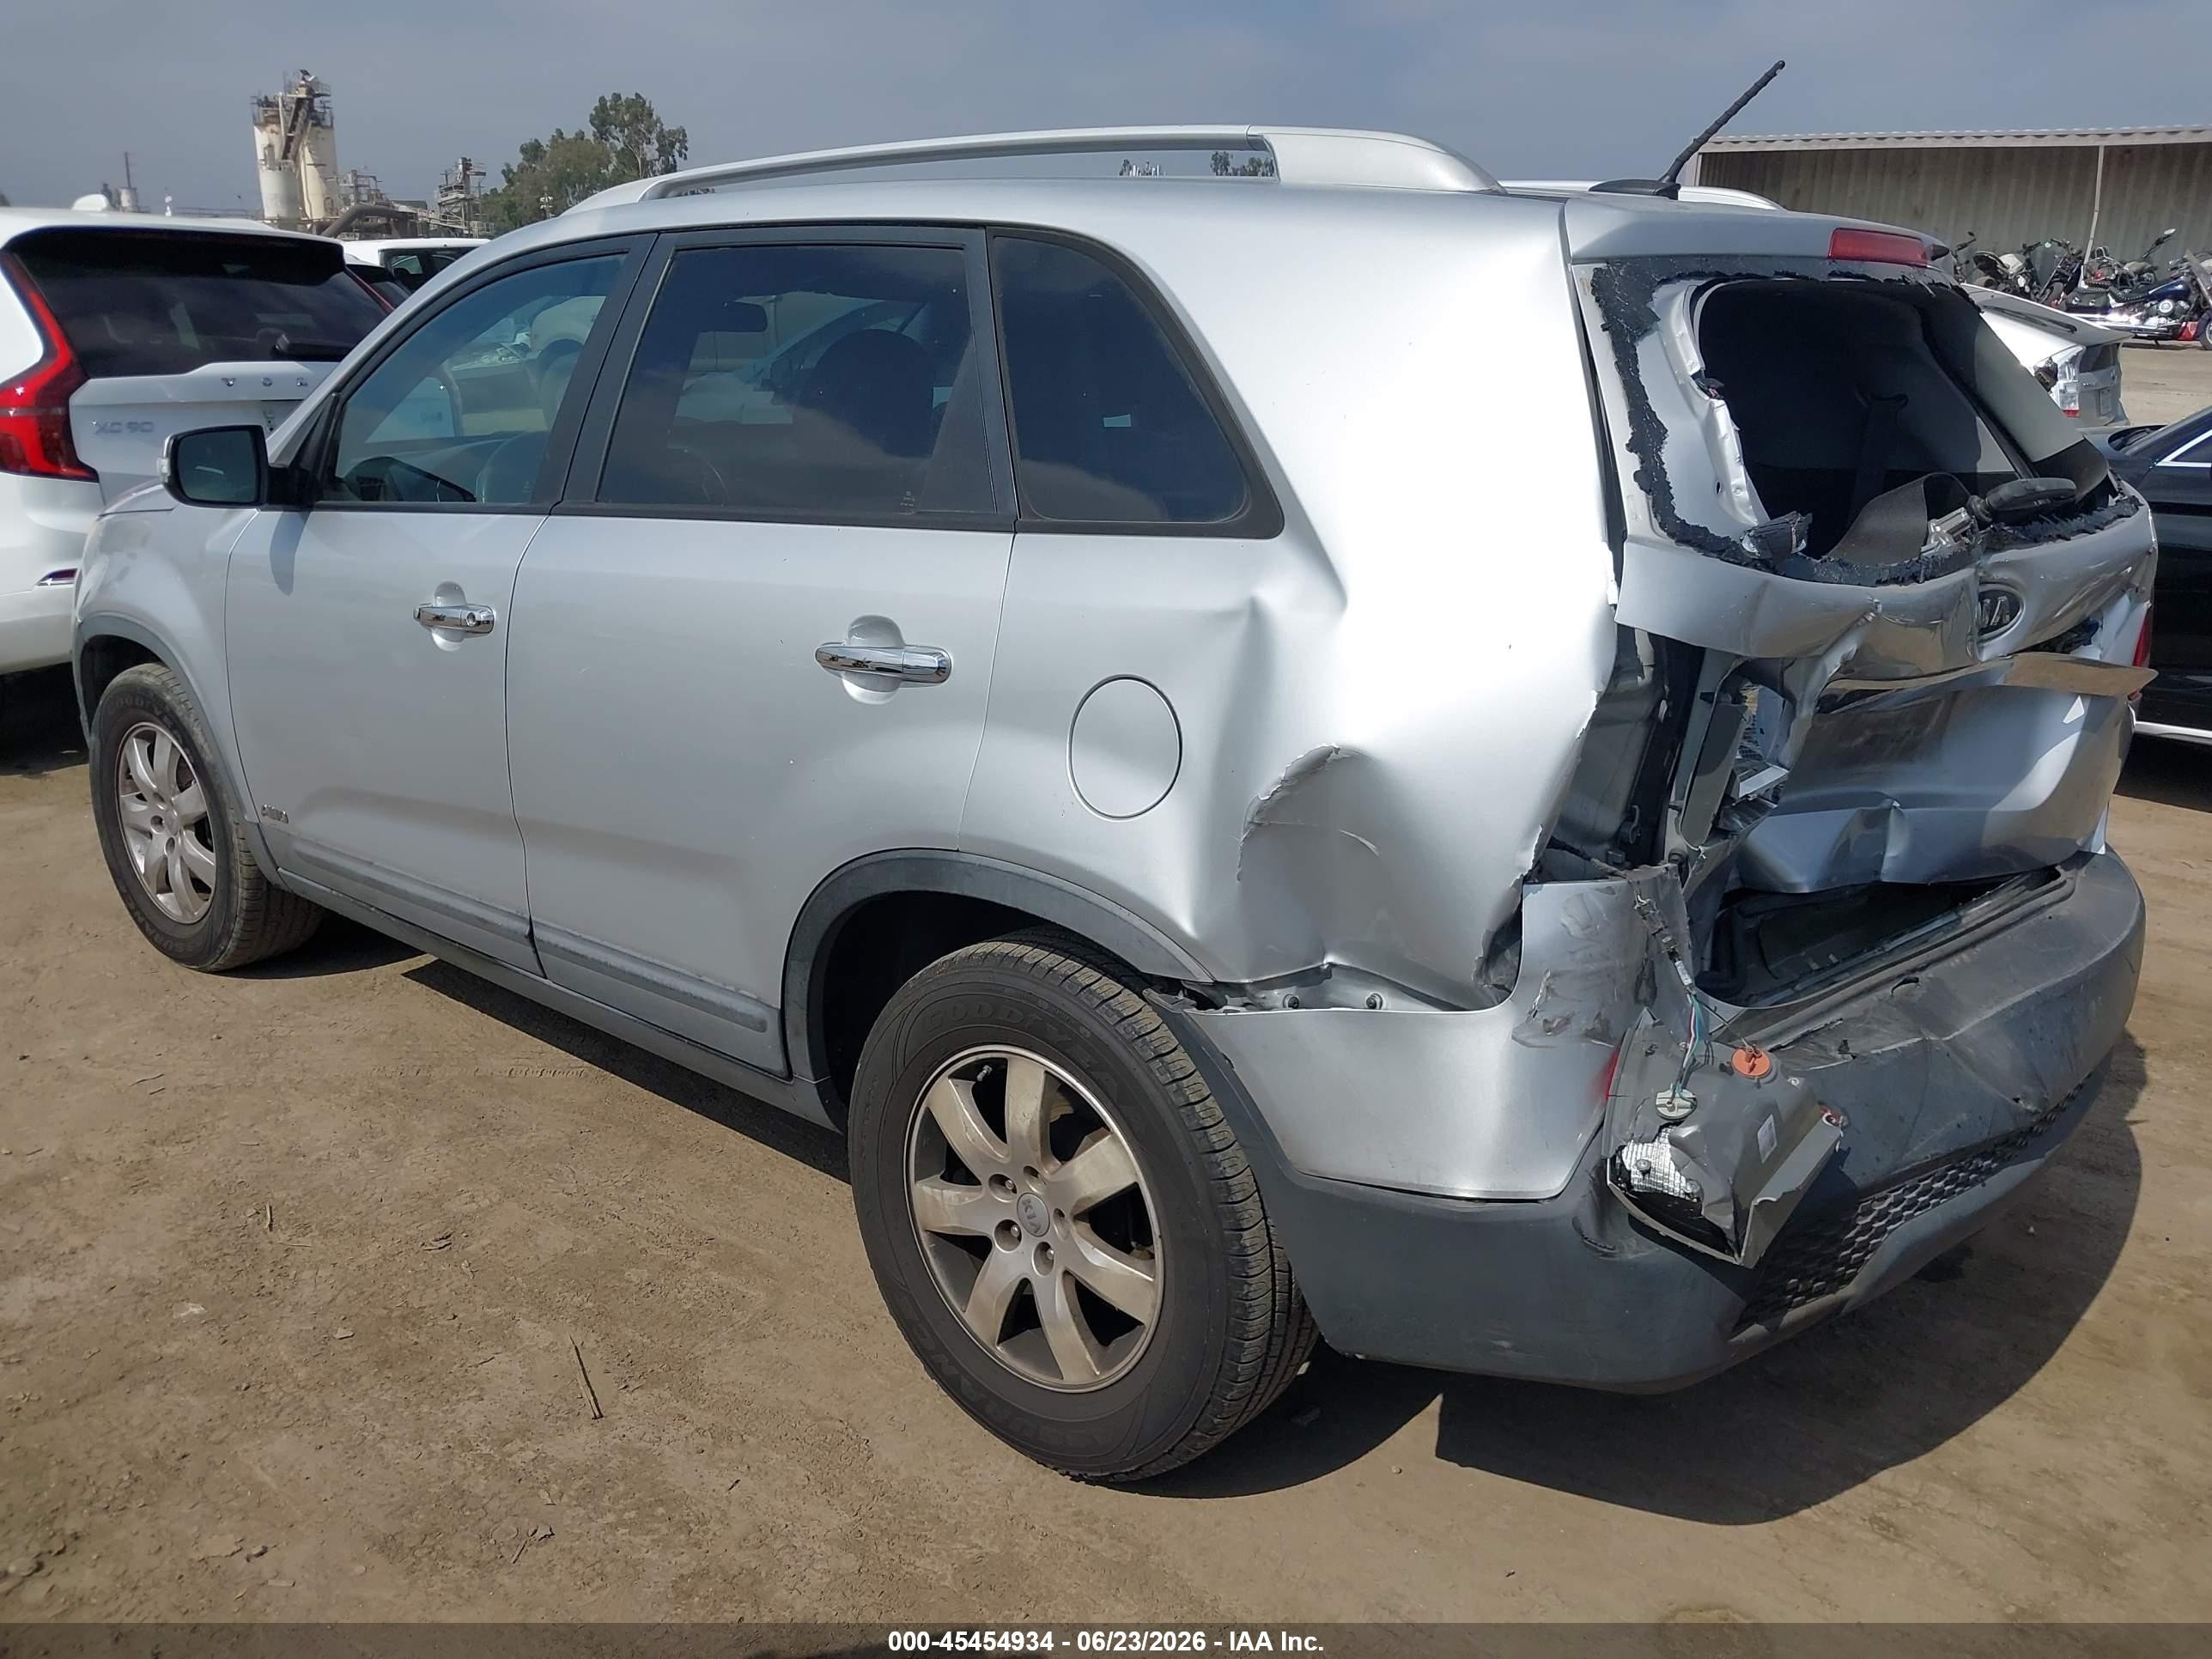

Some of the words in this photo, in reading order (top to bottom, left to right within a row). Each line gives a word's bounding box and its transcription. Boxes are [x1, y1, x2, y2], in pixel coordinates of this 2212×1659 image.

[222, 377, 308, 386] VOL
[928, 1002, 1143, 1138] GOODYEAR
[1021, 1198, 1042, 1234] KIA
